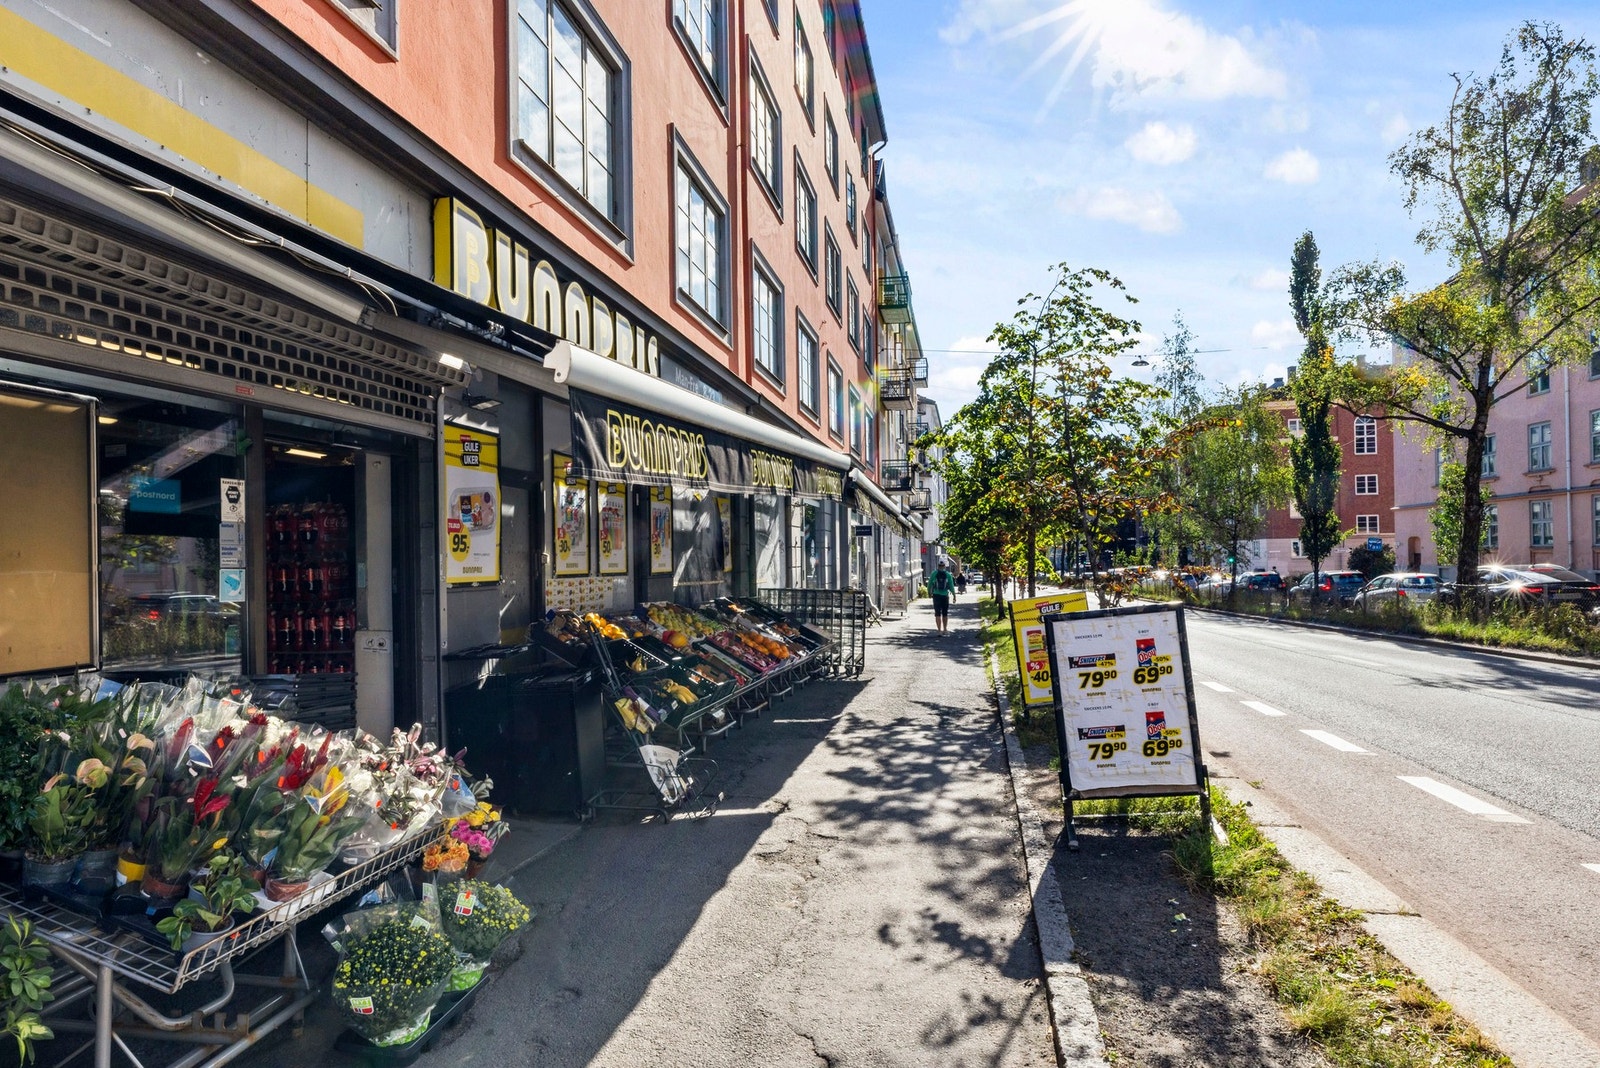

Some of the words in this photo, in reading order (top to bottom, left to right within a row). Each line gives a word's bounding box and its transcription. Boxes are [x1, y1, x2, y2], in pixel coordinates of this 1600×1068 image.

[464, 442, 479, 452] GULE
[606, 408, 708, 479] BUNNPRIS
[463, 454, 479, 465] UKER
[136, 491, 176, 500] postnord
[1041, 603, 1061, 614] GULE
